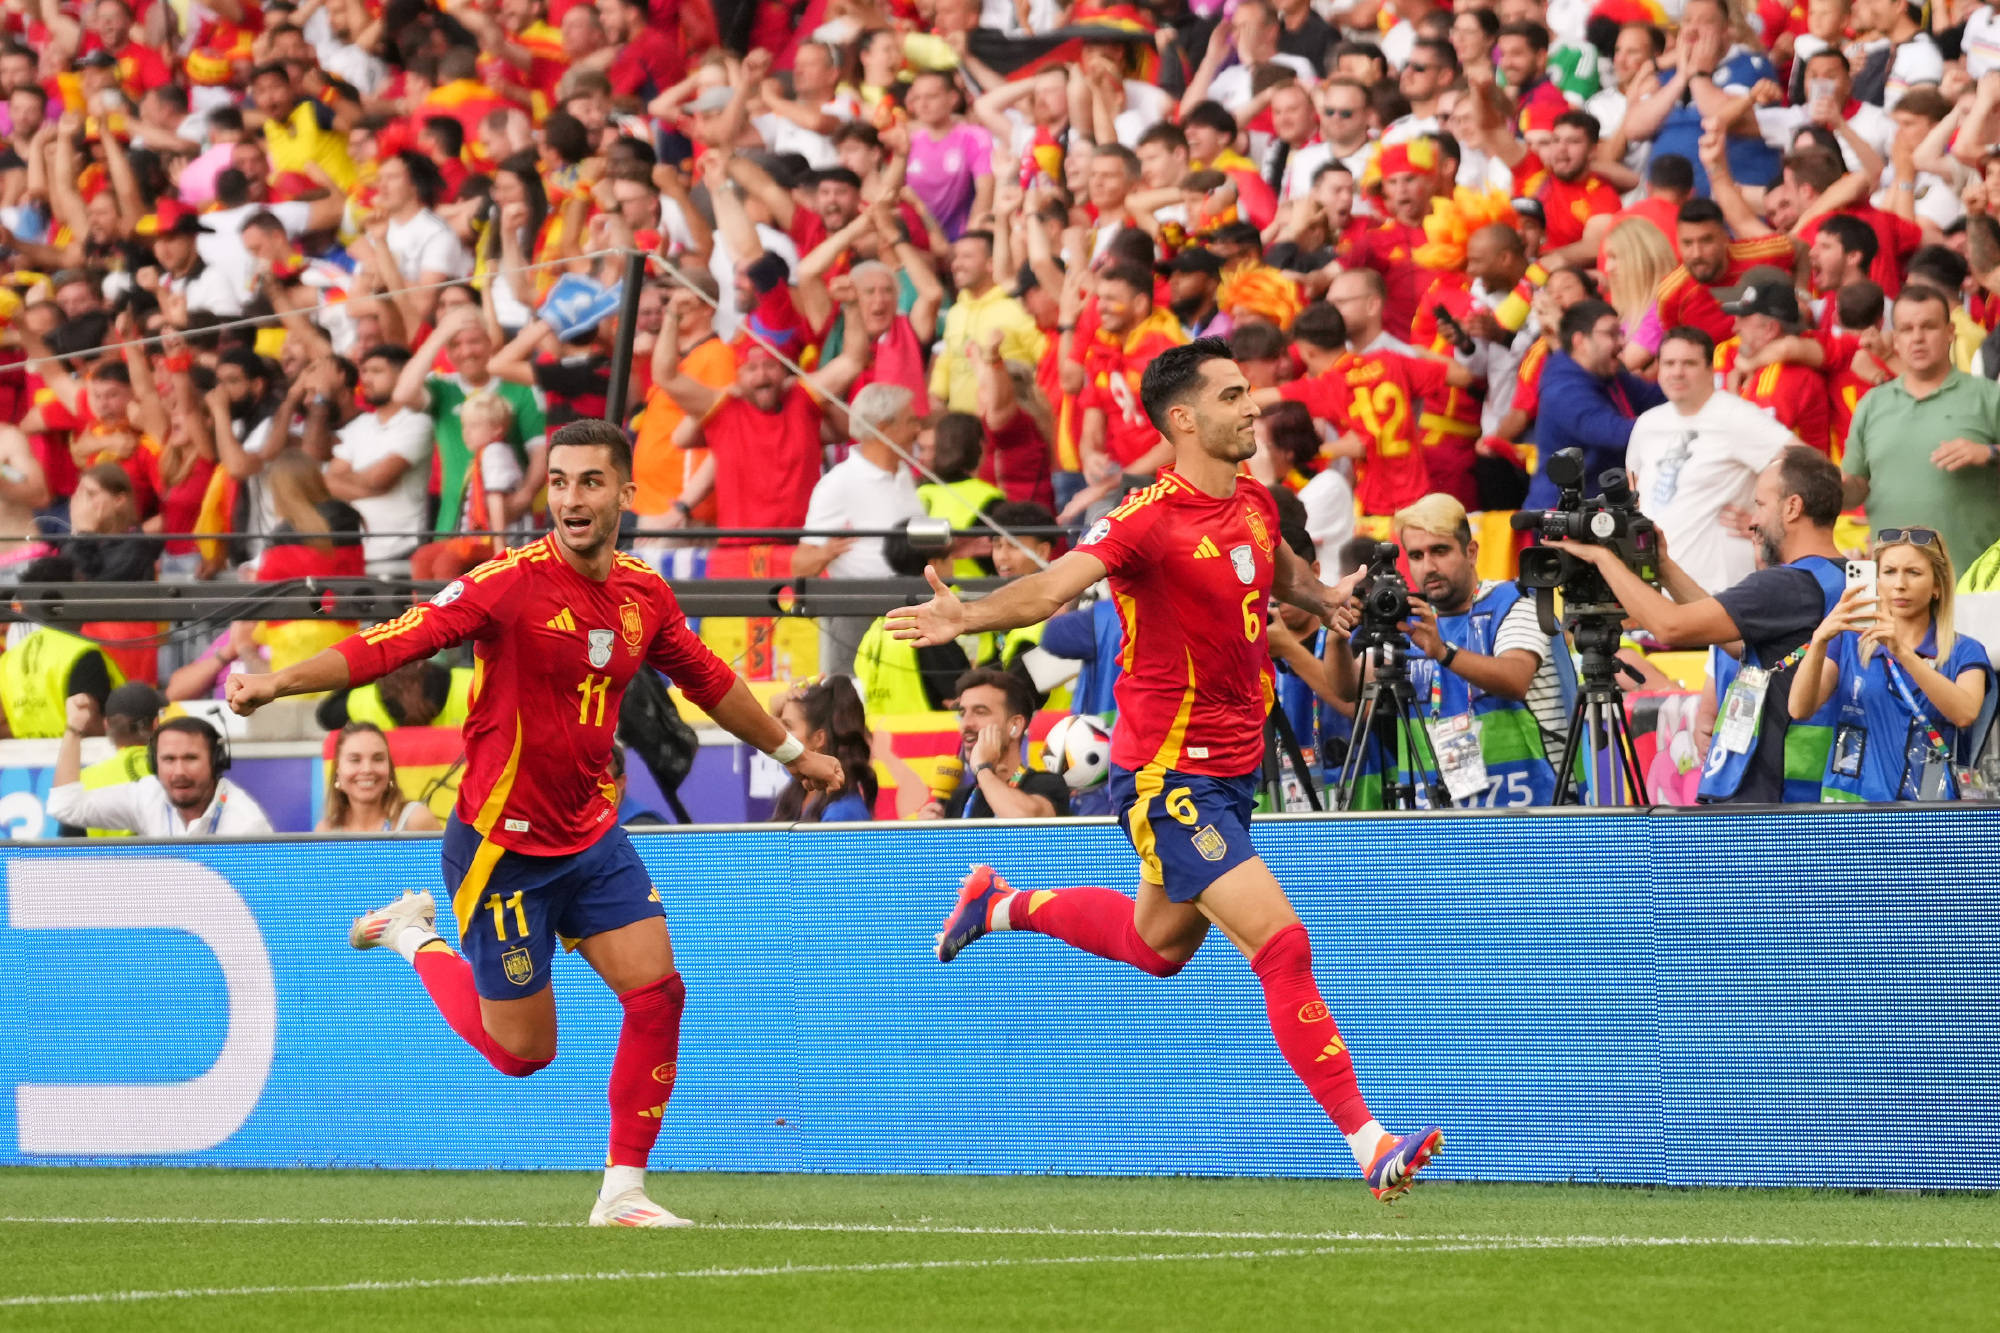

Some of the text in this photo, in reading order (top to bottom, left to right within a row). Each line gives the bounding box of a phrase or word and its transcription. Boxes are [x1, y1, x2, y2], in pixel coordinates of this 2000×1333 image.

[1347, 381, 1410, 457] 12
[1241, 589, 1260, 643] 6
[577, 674, 612, 727] 11
[1165, 786, 1199, 826] 6
[484, 890, 530, 941] 11
